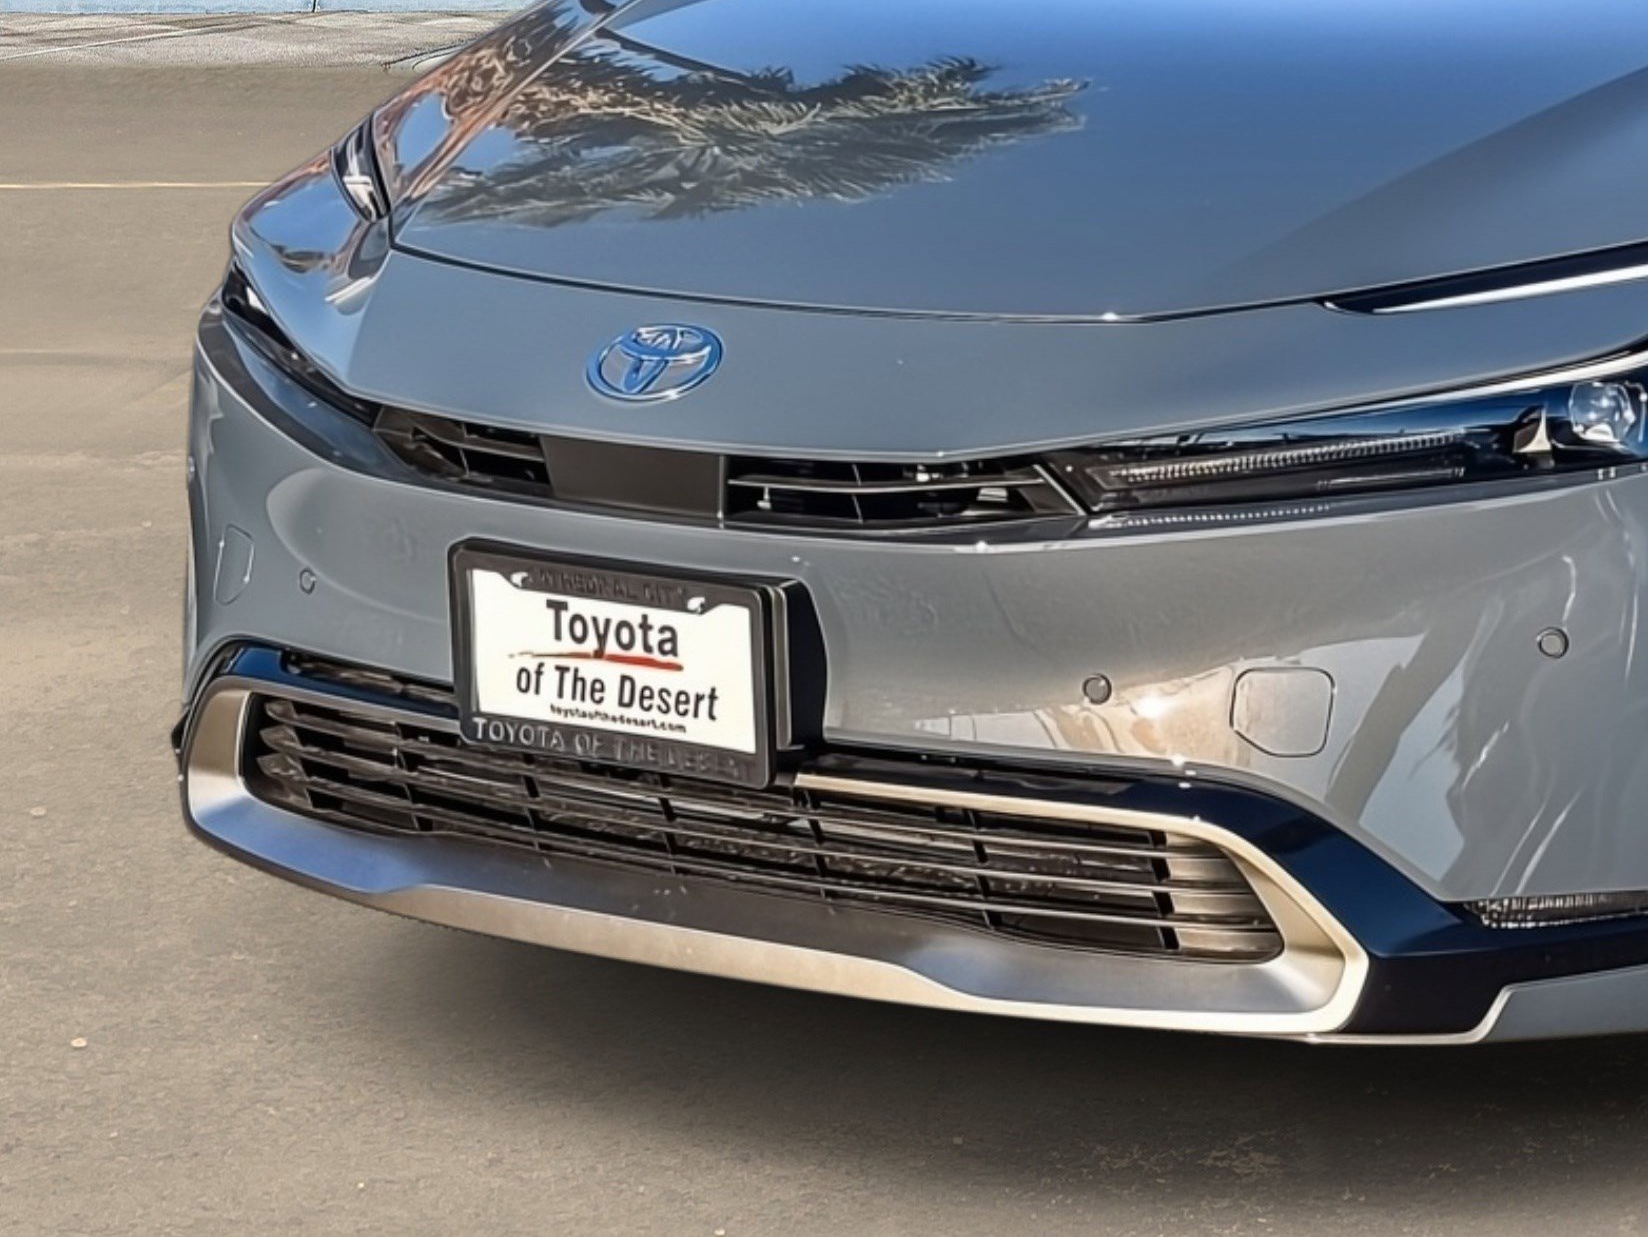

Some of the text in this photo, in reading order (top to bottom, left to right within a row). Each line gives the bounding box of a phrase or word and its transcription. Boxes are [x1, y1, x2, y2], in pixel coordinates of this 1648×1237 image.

[546, 599, 679, 658] Toyota
[516, 663, 719, 722] of The Desert
[473, 717, 565, 751] TOYOTA
[575, 734, 602, 757] OF
[614, 737, 659, 763] THE
